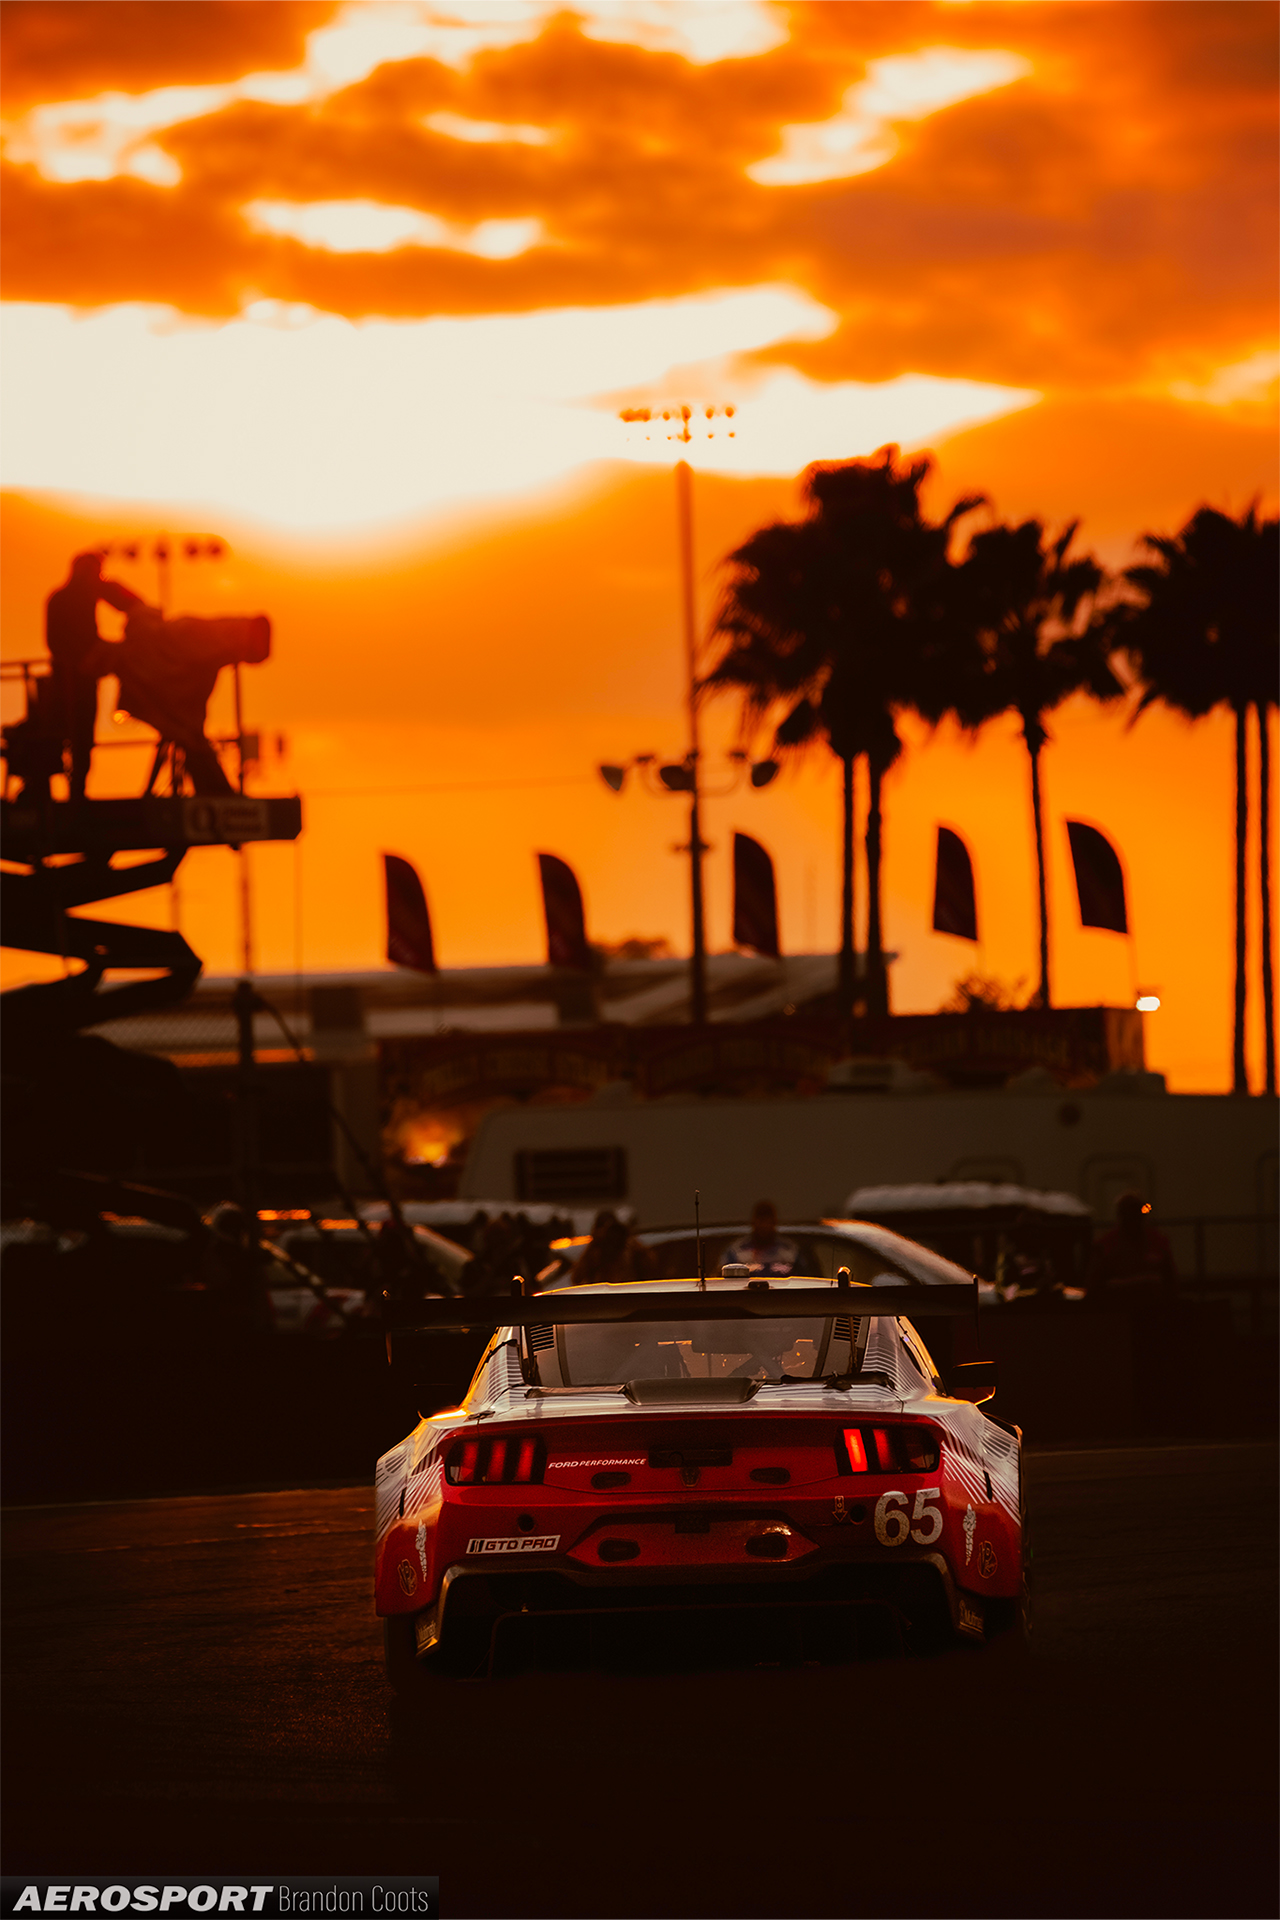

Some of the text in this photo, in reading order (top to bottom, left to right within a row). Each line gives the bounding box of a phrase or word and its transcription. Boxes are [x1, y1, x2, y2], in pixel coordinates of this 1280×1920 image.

[548, 1458, 647, 1470] FORD PERFORMANCE
[873, 1486, 944, 1547] 65
[485, 1537, 557, 1551] GTD PRO
